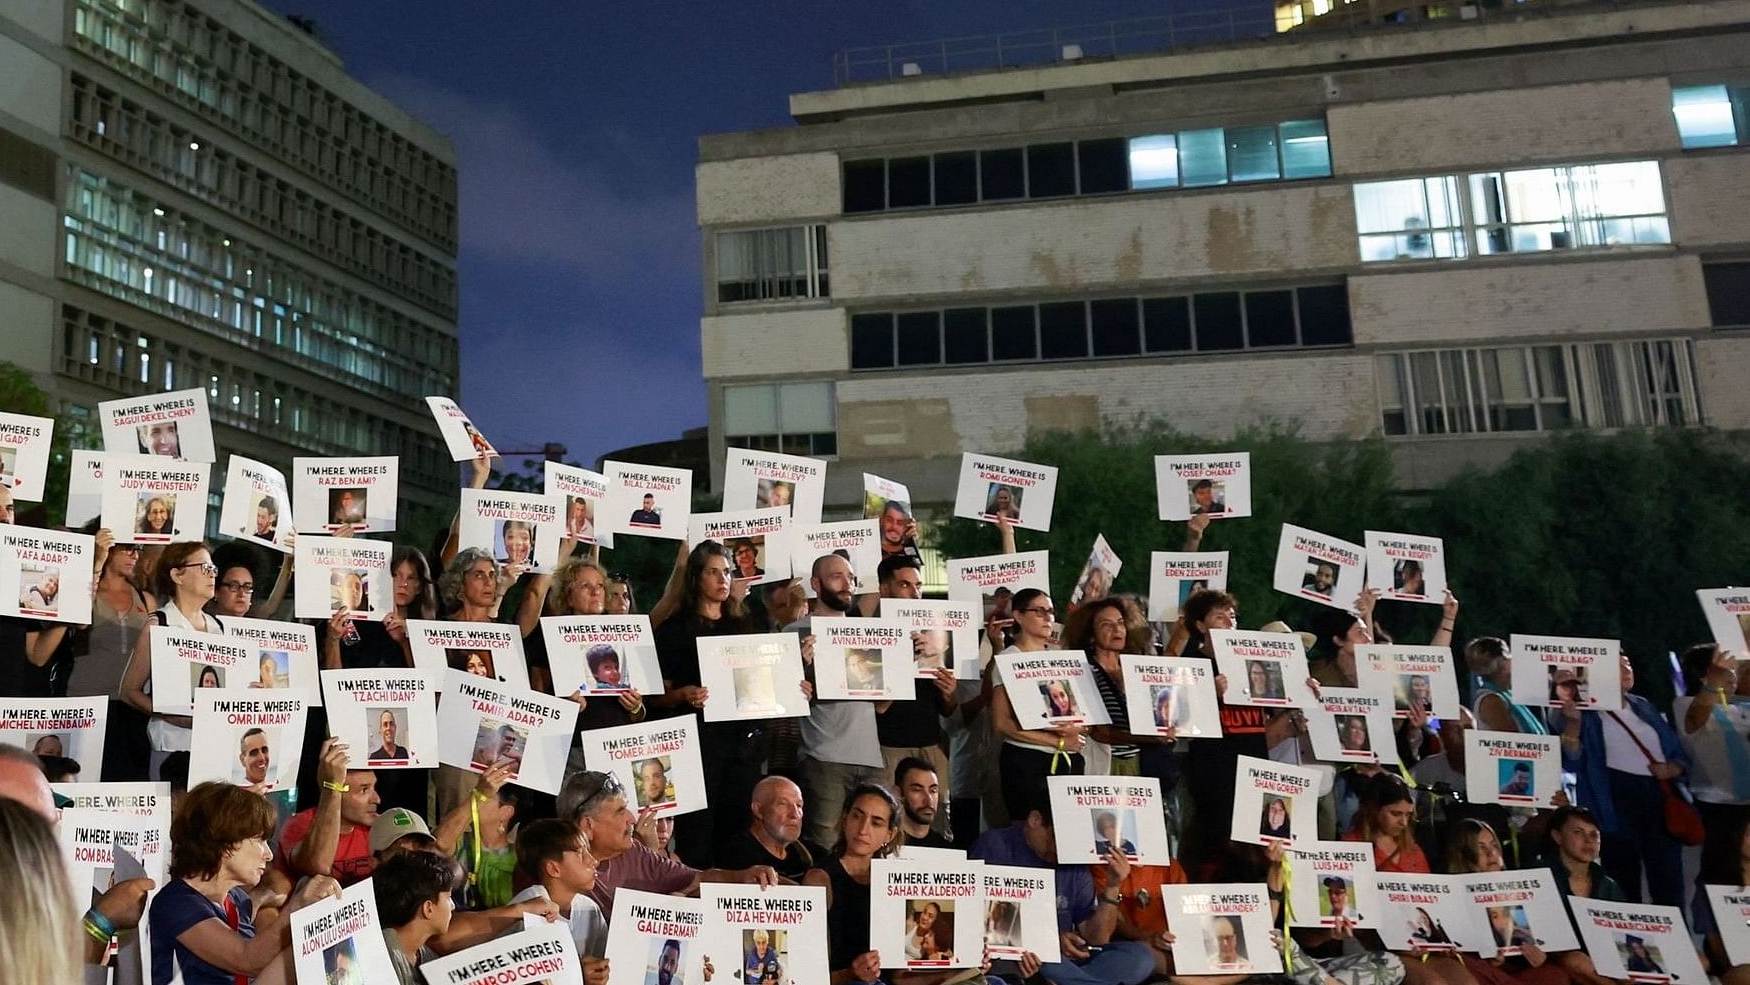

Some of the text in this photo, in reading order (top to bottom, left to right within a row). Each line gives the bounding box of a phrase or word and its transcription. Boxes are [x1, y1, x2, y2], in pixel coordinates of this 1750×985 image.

[32, 427, 42, 437] IS
[3, 433, 29, 445] GAD?
[119, 470, 134, 480] I'M
[160, 472, 192, 482] WHERE
[191, 473, 200, 482] IS
[306, 466, 320, 475] I'M
[347, 466, 378, 475] WHERE
[377, 466, 387, 475] IS
[972, 462, 986, 471] I'M
[1007, 467, 1037, 479] WHERE
[1037, 472, 1046, 481] IS
[119, 480, 198, 492] JUDY WEINSTEIN?
[318, 476, 377, 485] RAZ BEN AMI?
[3, 536, 17, 547] I'M
[43, 540, 74, 554] WHERE
[74, 543, 82, 555] IS
[16, 548, 70, 564] YAFA ADAR?
[423, 629, 439, 638] I'M
[467, 631, 501, 641] WHERE
[501, 632, 512, 641] IS
[558, 625, 573, 634] I'M
[601, 624, 632, 633] WHERE
[632, 624, 642, 633] IS
[826, 627, 840, 636] I'M
[864, 628, 893, 637] WHERE
[893, 628, 903, 637] IS
[427, 637, 510, 649] OFRY BRODUTCH?
[563, 633, 640, 643] ORIA BRODUTCH?
[831, 637, 880, 646] AVINATHAN
[166, 637, 182, 648] I'M
[205, 643, 238, 656] WHERE
[238, 647, 247, 658] IS
[1524, 644, 1540, 653] I'M
[1567, 646, 1598, 655] WHERE
[1598, 647, 1608, 656] IS
[177, 648, 237, 665] SHIRI WEISS?
[337, 680, 355, 691] I'M
[383, 680, 416, 691] WHERE
[416, 680, 425, 690] IS
[352, 691, 416, 702] TZACHI IDAN?
[213, 701, 229, 712] I'M
[261, 700, 292, 712] WHERE
[292, 700, 301, 711] IS
[2, 709, 19, 719] I'M
[49, 708, 85, 719] WHERE
[85, 708, 94, 718] IS
[226, 714, 292, 725] OMRI MIRAN?
[36, 718, 97, 729] NISENBAUM?
[1248, 768, 1260, 779] I'M
[1278, 773, 1303, 786] WHERE
[1302, 777, 1311, 787] IS
[887, 873, 902, 885] I'M
[932, 873, 967, 885] WHERE
[967, 873, 976, 885] IS
[886, 886, 976, 896] SAHAR KALDERON?
[716, 898, 734, 910] I'M
[763, 899, 802, 912] WHERE
[802, 900, 813, 912] IS
[303, 922, 315, 940] I'M
[334, 902, 358, 924] WHERE
[357, 899, 365, 914] IS
[630, 905, 647, 918] I'M
[674, 911, 699, 924] WHERE
[726, 911, 803, 924] DIZA HEYMAN?
[636, 921, 662, 934] GALI
[447, 967, 471, 983] I'M
[507, 942, 552, 963] WHERE
[552, 940, 563, 953] IS
